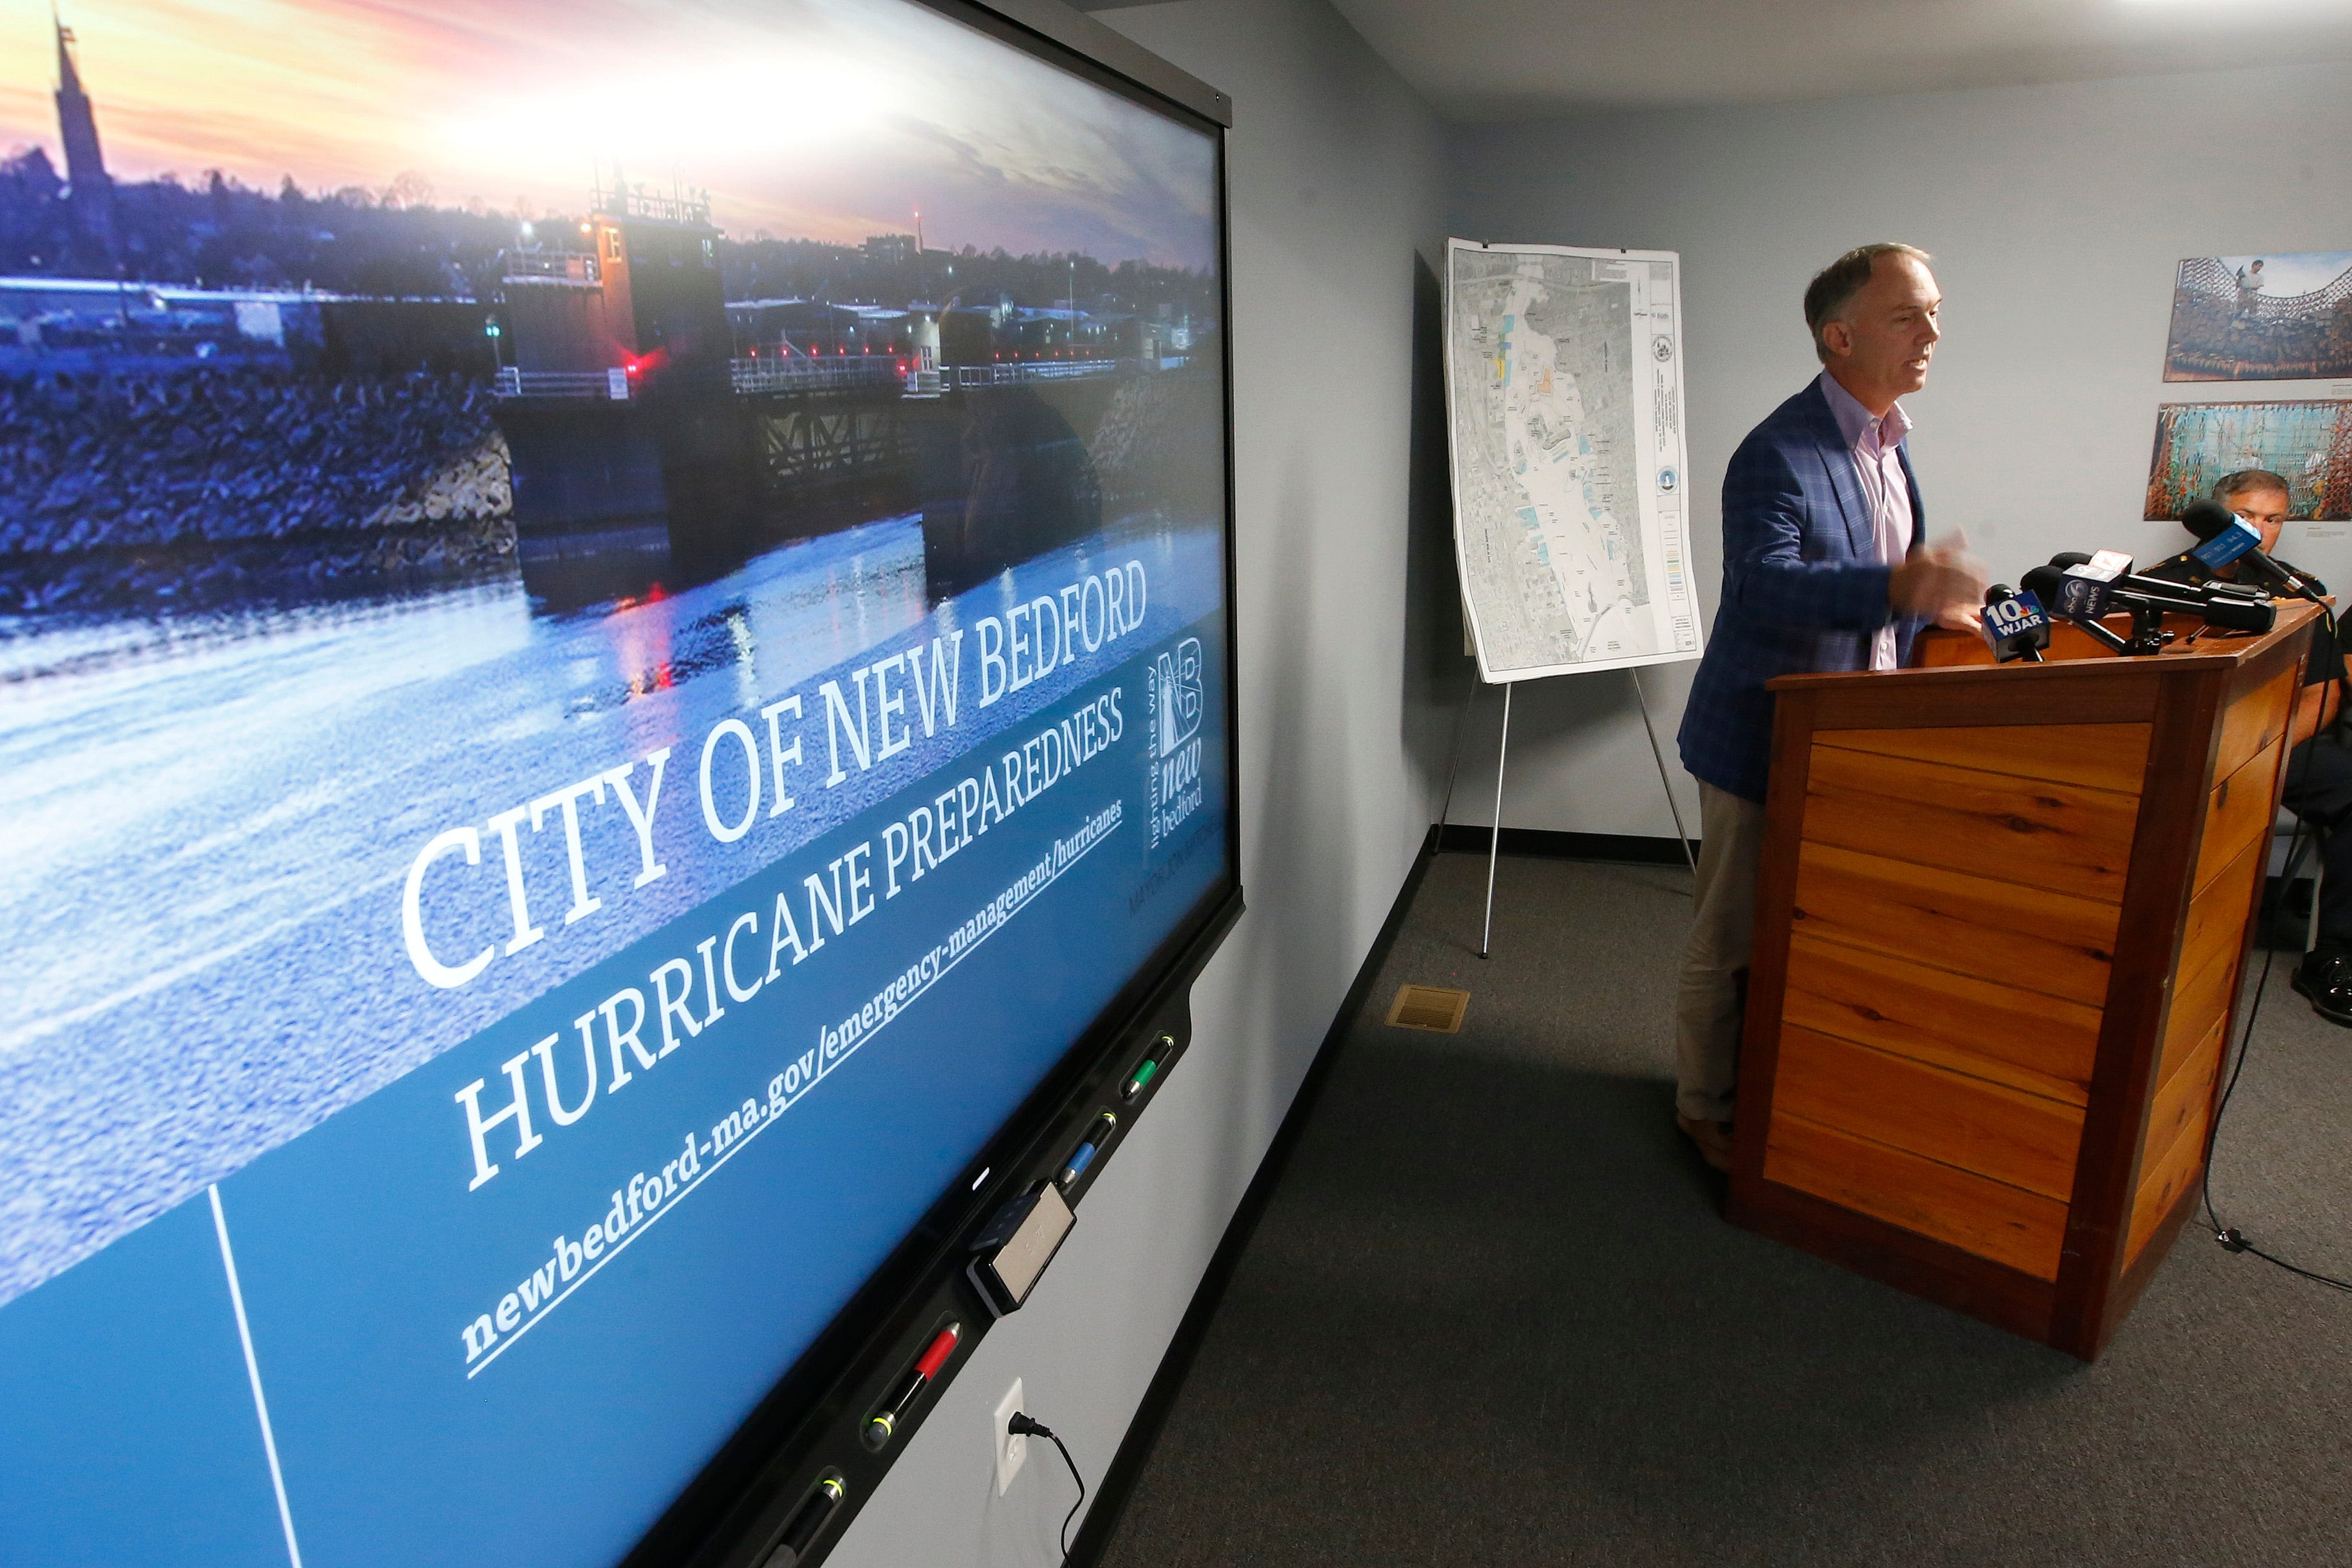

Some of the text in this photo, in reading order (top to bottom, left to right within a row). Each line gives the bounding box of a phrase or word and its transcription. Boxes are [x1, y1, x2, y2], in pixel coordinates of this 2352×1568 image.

[1986, 600, 2022, 627] 10
[1998, 615, 2043, 637] WJAR
[2085, 586, 2100, 613] NEWS
[1147, 665, 1157, 714] way
[1149, 719, 1158, 758] the
[401, 559, 1149, 990] CITY OF NEW BEDFORD
[1162, 737, 1202, 806] new
[1161, 777, 1203, 838] bedford
[454, 687, 1123, 1192] HURRICANE PREPAREDNESS
[462, 797, 1123, 1365] newbedford-ma.gov/emergency-management/hurricanes
